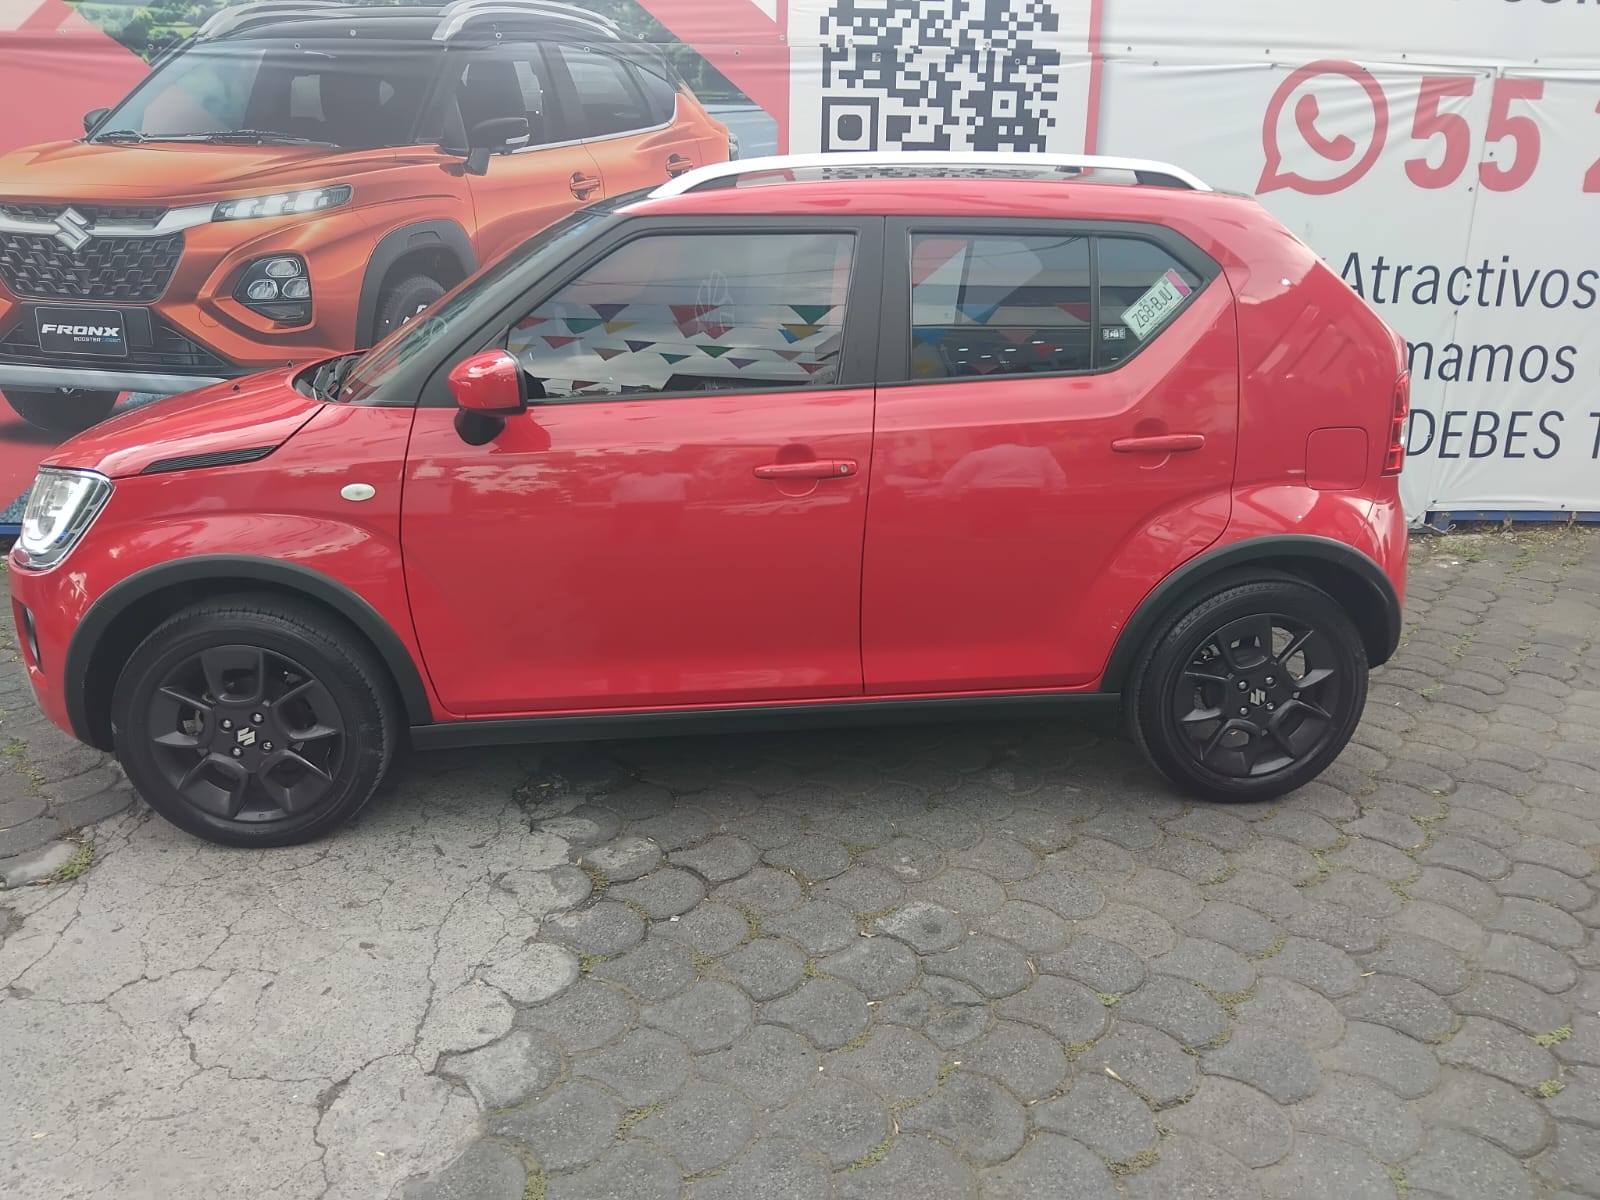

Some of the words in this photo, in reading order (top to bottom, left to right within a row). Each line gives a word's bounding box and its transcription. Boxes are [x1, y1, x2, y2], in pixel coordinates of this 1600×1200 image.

[1404, 75, 1545, 192] 55
[1341, 252, 1600, 309] Atractivos
[41, 323, 120, 337] FRONX
[1406, 409, 1565, 459] DEBES
